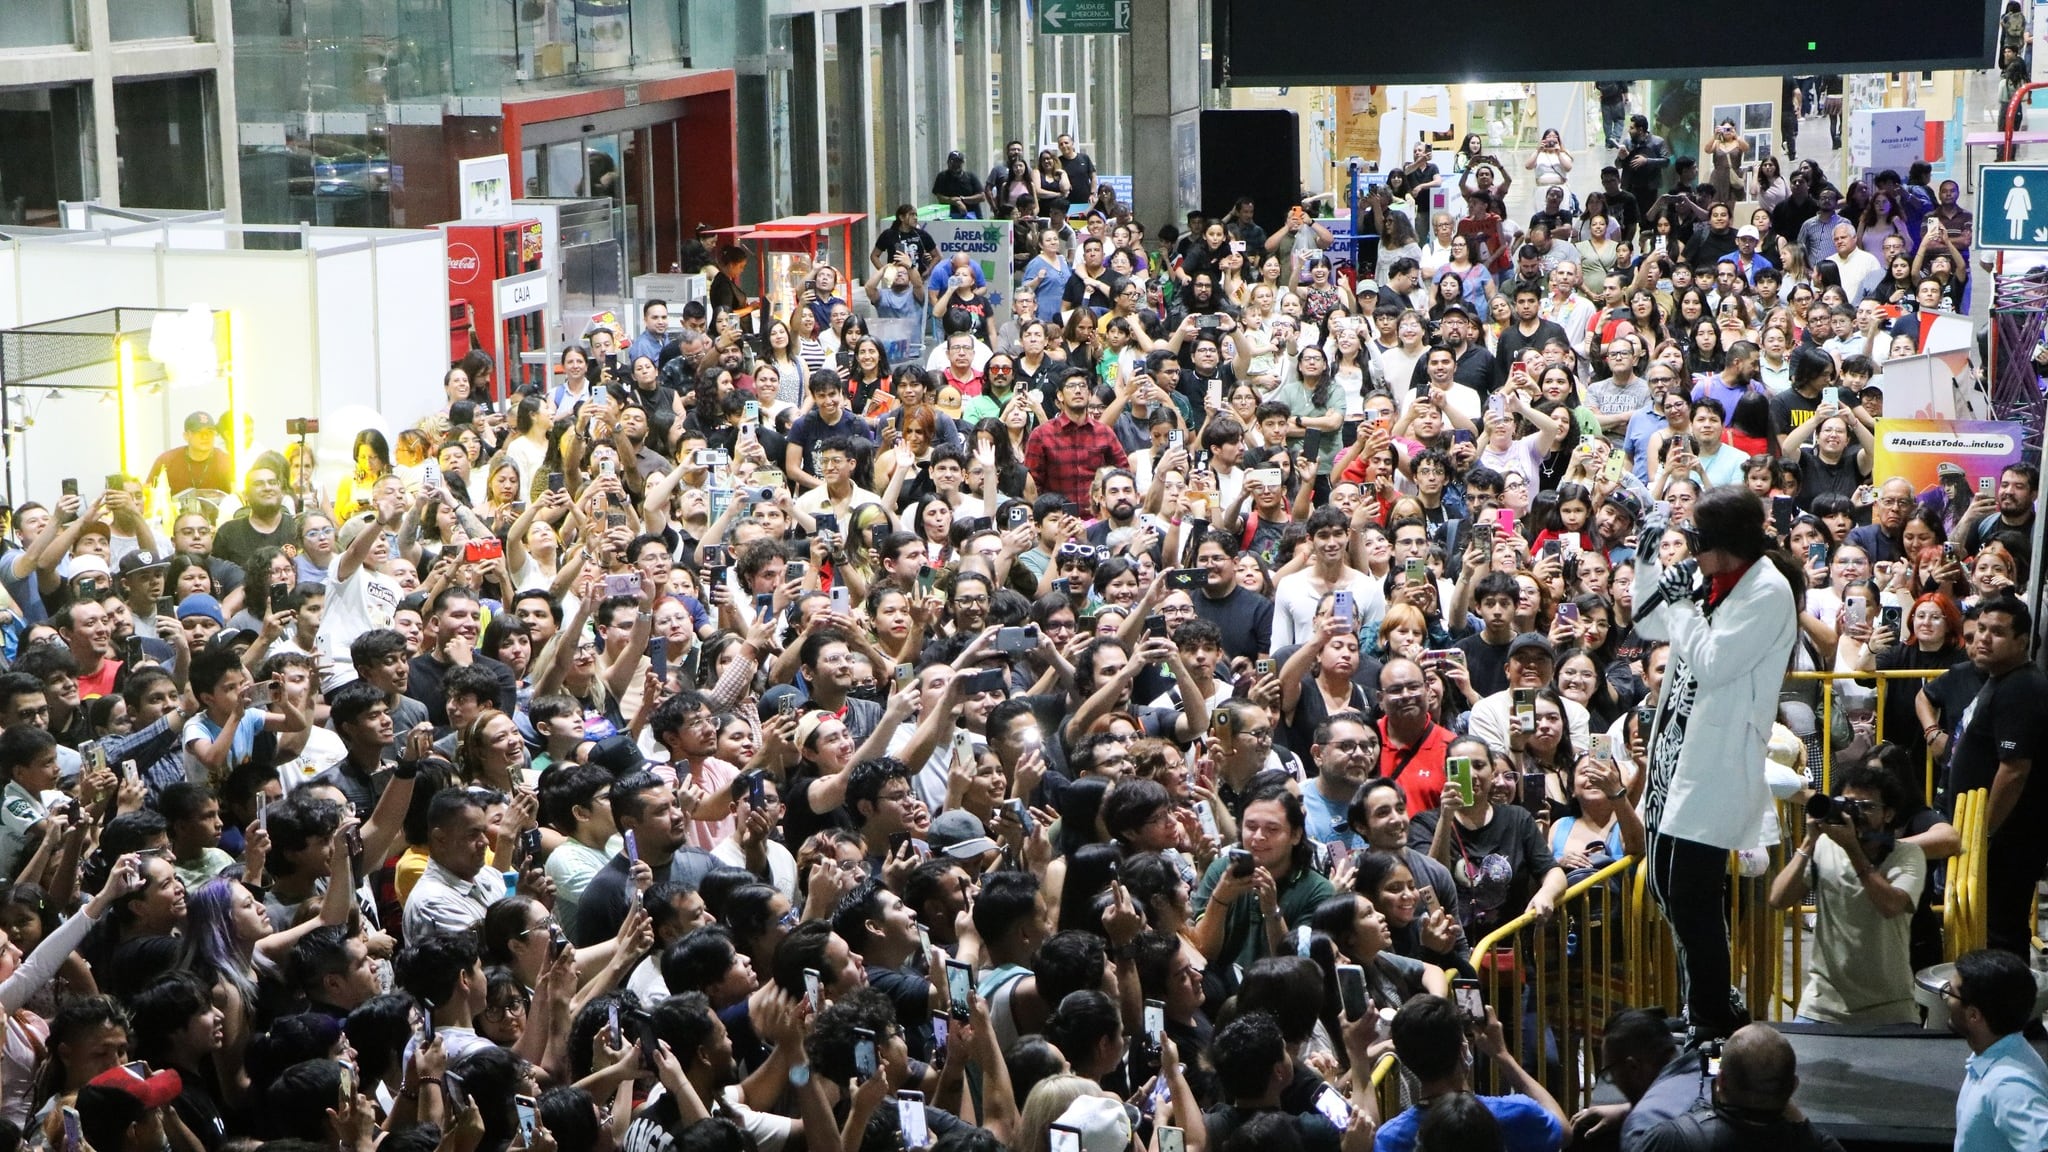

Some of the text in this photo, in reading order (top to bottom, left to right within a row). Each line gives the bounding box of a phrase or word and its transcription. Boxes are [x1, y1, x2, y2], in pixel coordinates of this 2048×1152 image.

[954, 228, 998, 240] ÁREA DE
[941, 242, 997, 253] DESCANSO
[514, 285, 530, 303] CAJA
